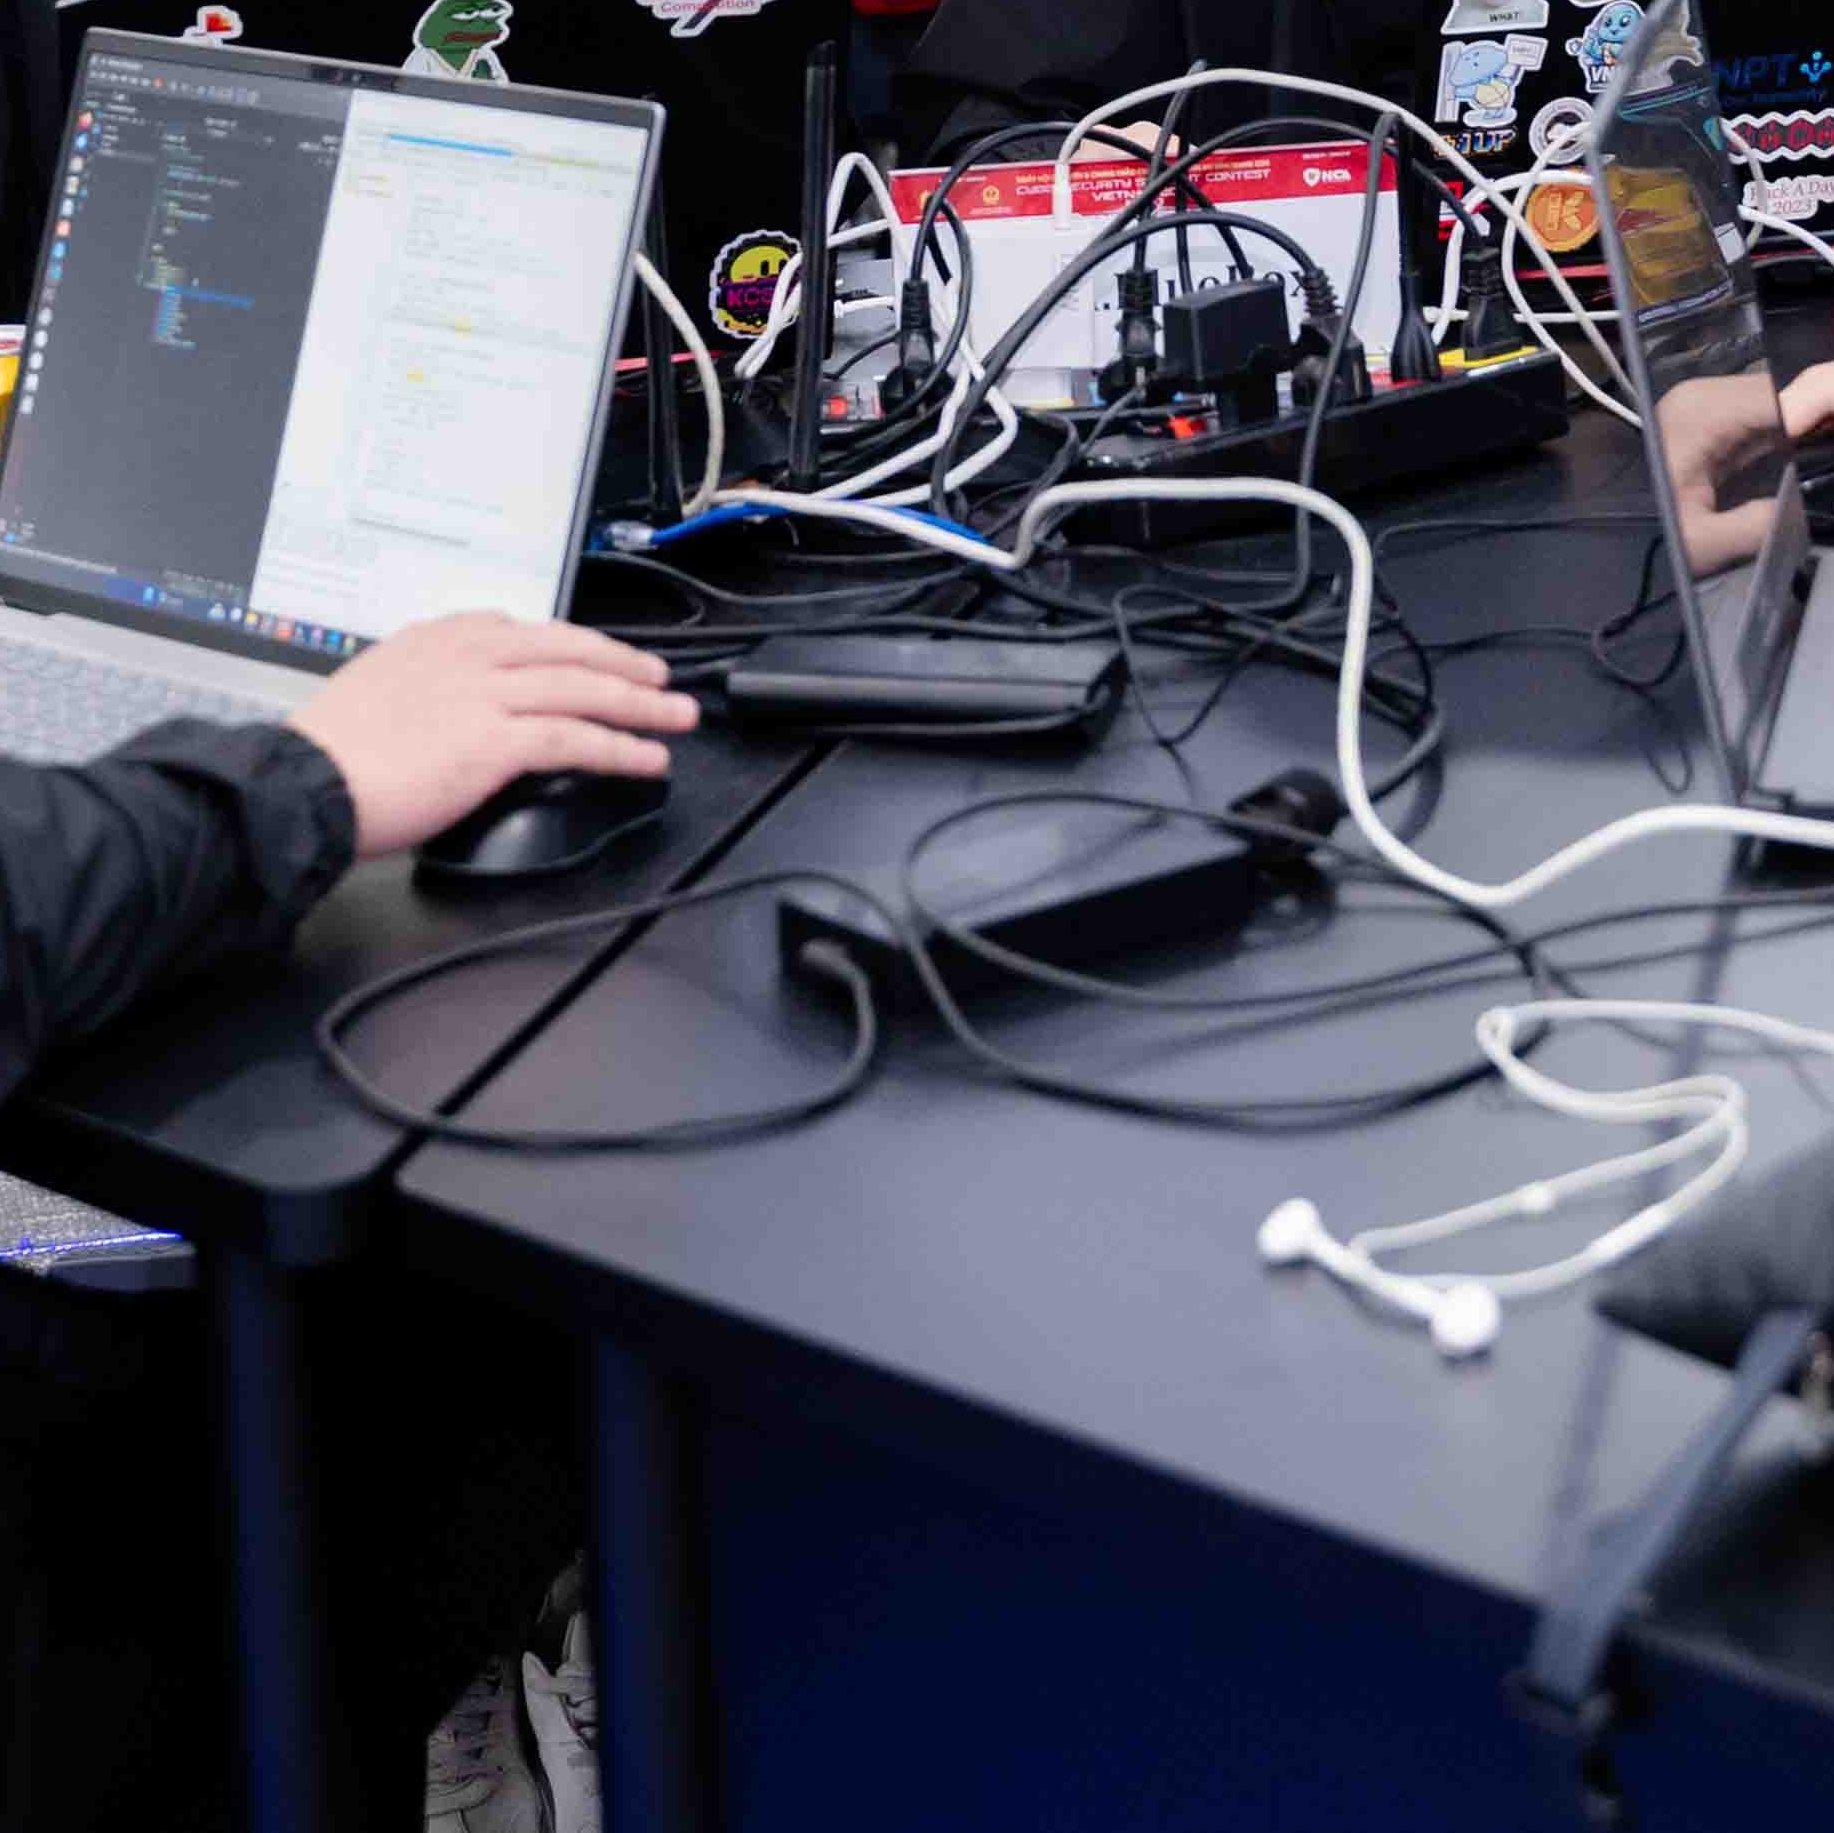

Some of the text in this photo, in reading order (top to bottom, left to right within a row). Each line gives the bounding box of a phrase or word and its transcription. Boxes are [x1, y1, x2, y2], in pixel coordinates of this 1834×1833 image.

[1489, 12, 1520, 23] WHAT
[1793, 181, 1805, 196] A
[1773, 199, 1814, 215] 2023
